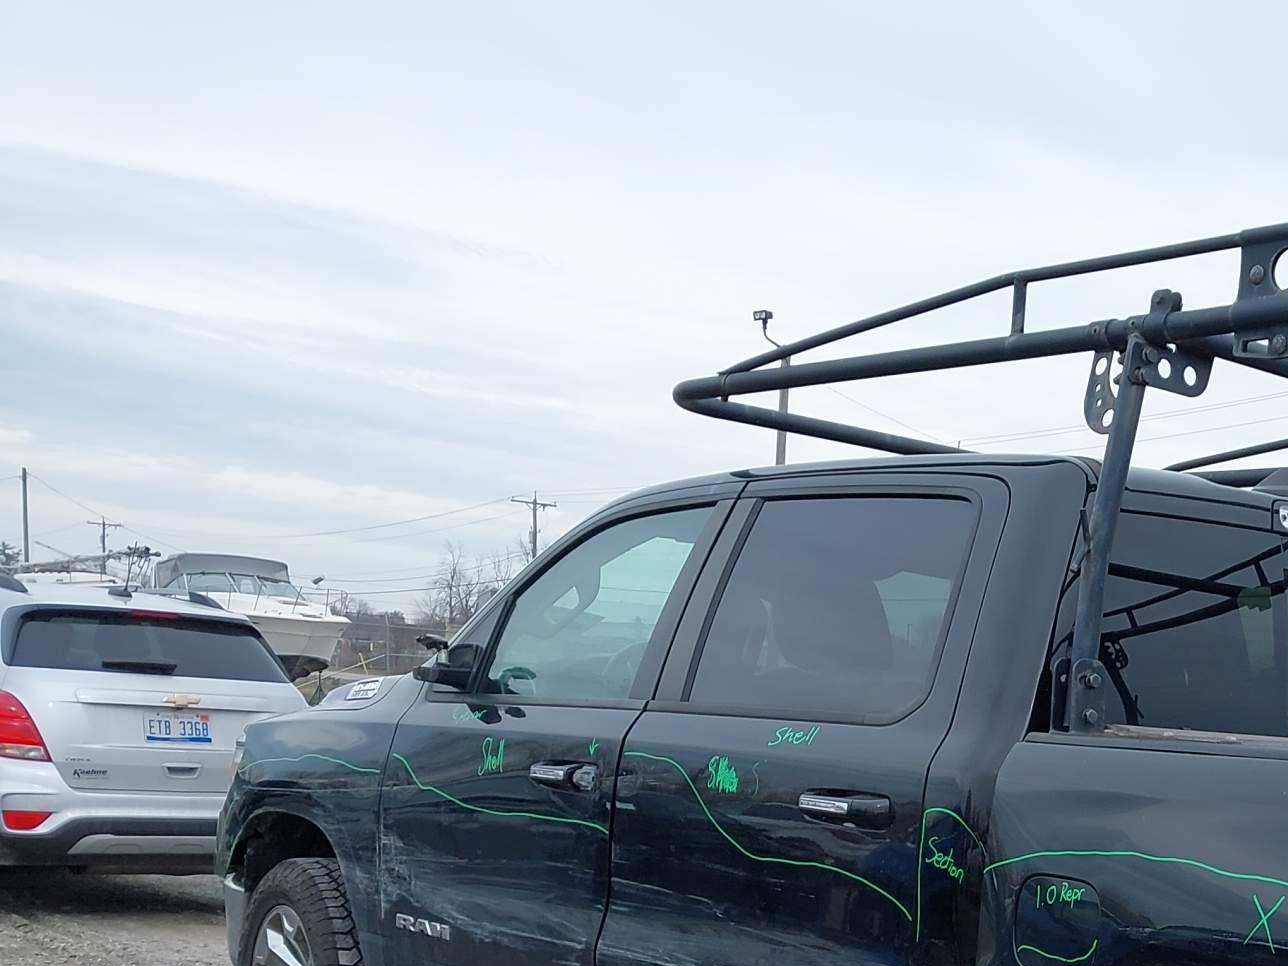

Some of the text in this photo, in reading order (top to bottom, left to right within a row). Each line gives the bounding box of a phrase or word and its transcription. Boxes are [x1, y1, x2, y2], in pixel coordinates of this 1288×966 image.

[149, 720, 209, 737] ETB 3368
[767, 726, 821, 746] Shell
[925, 836, 965, 885] Section
[396, 913, 450, 941] RAM
